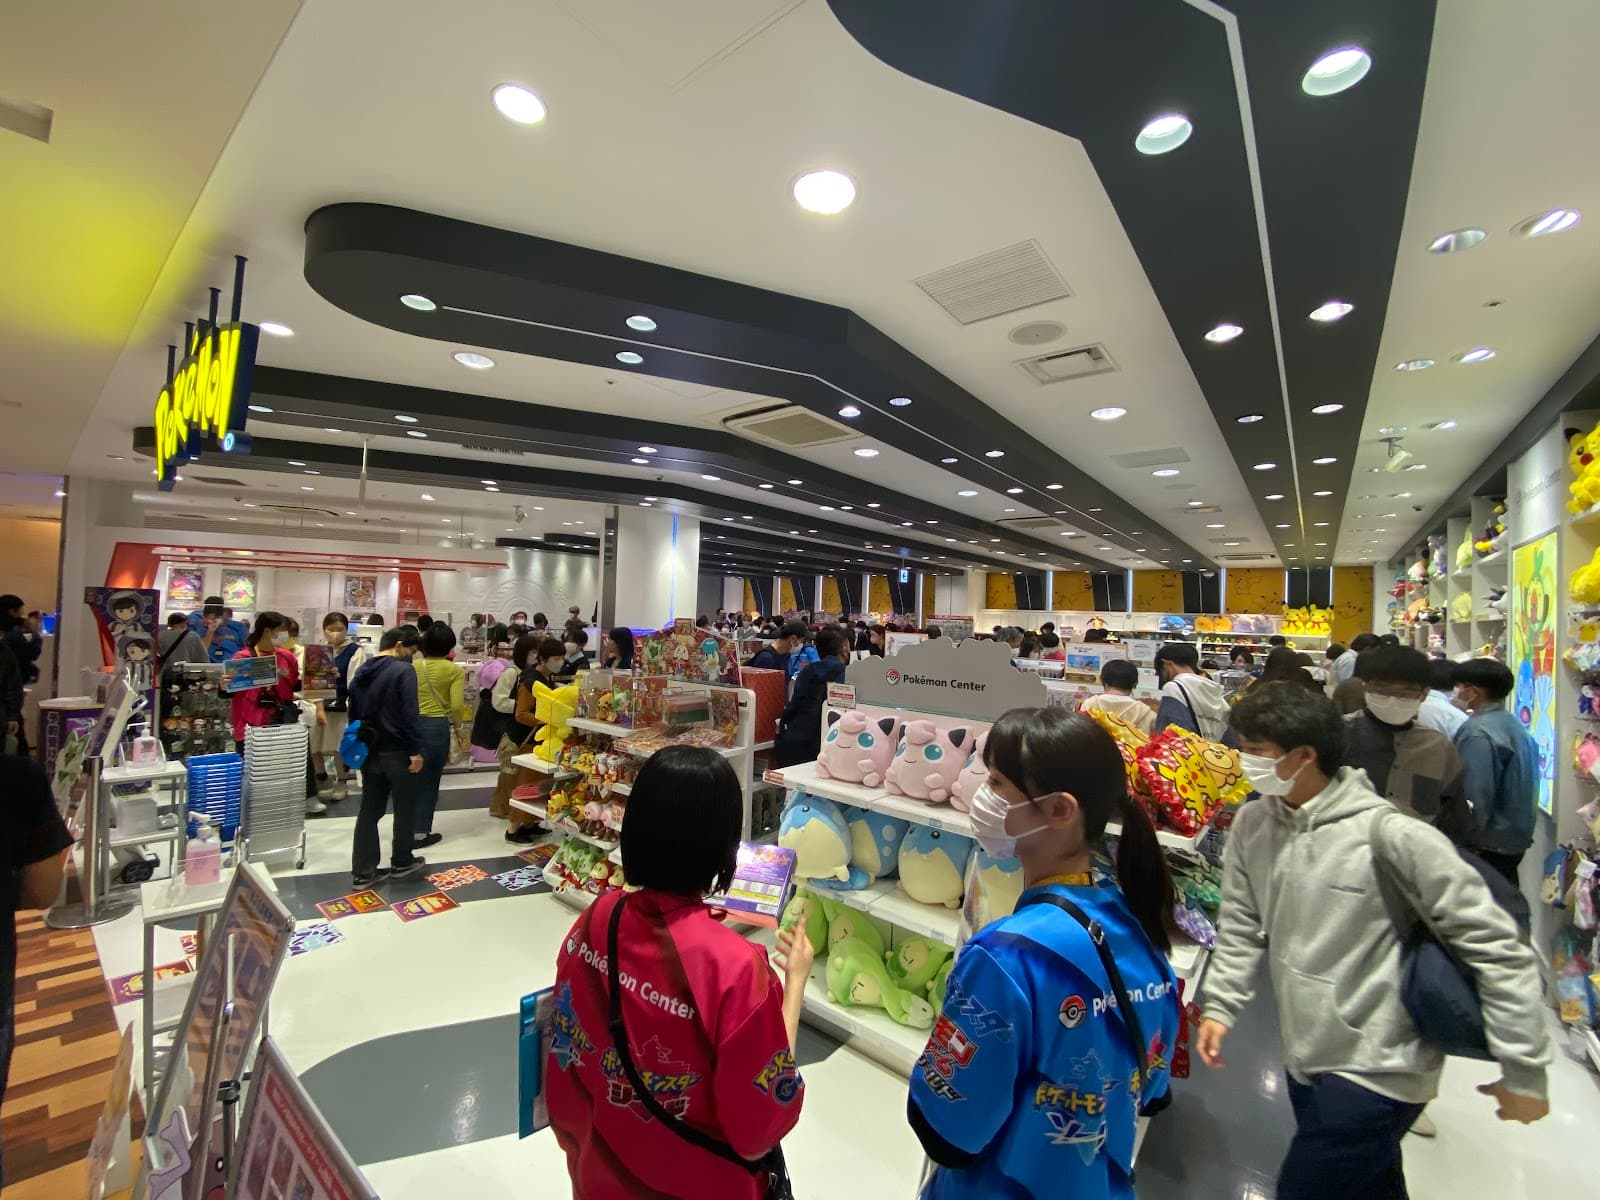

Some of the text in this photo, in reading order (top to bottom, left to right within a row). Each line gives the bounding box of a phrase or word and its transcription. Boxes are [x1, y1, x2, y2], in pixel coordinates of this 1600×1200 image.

[903, 674, 986, 691] Pokémon Center
[578, 942, 696, 1019] Pokéon Center
[1092, 988, 1144, 1017] Pokéon
